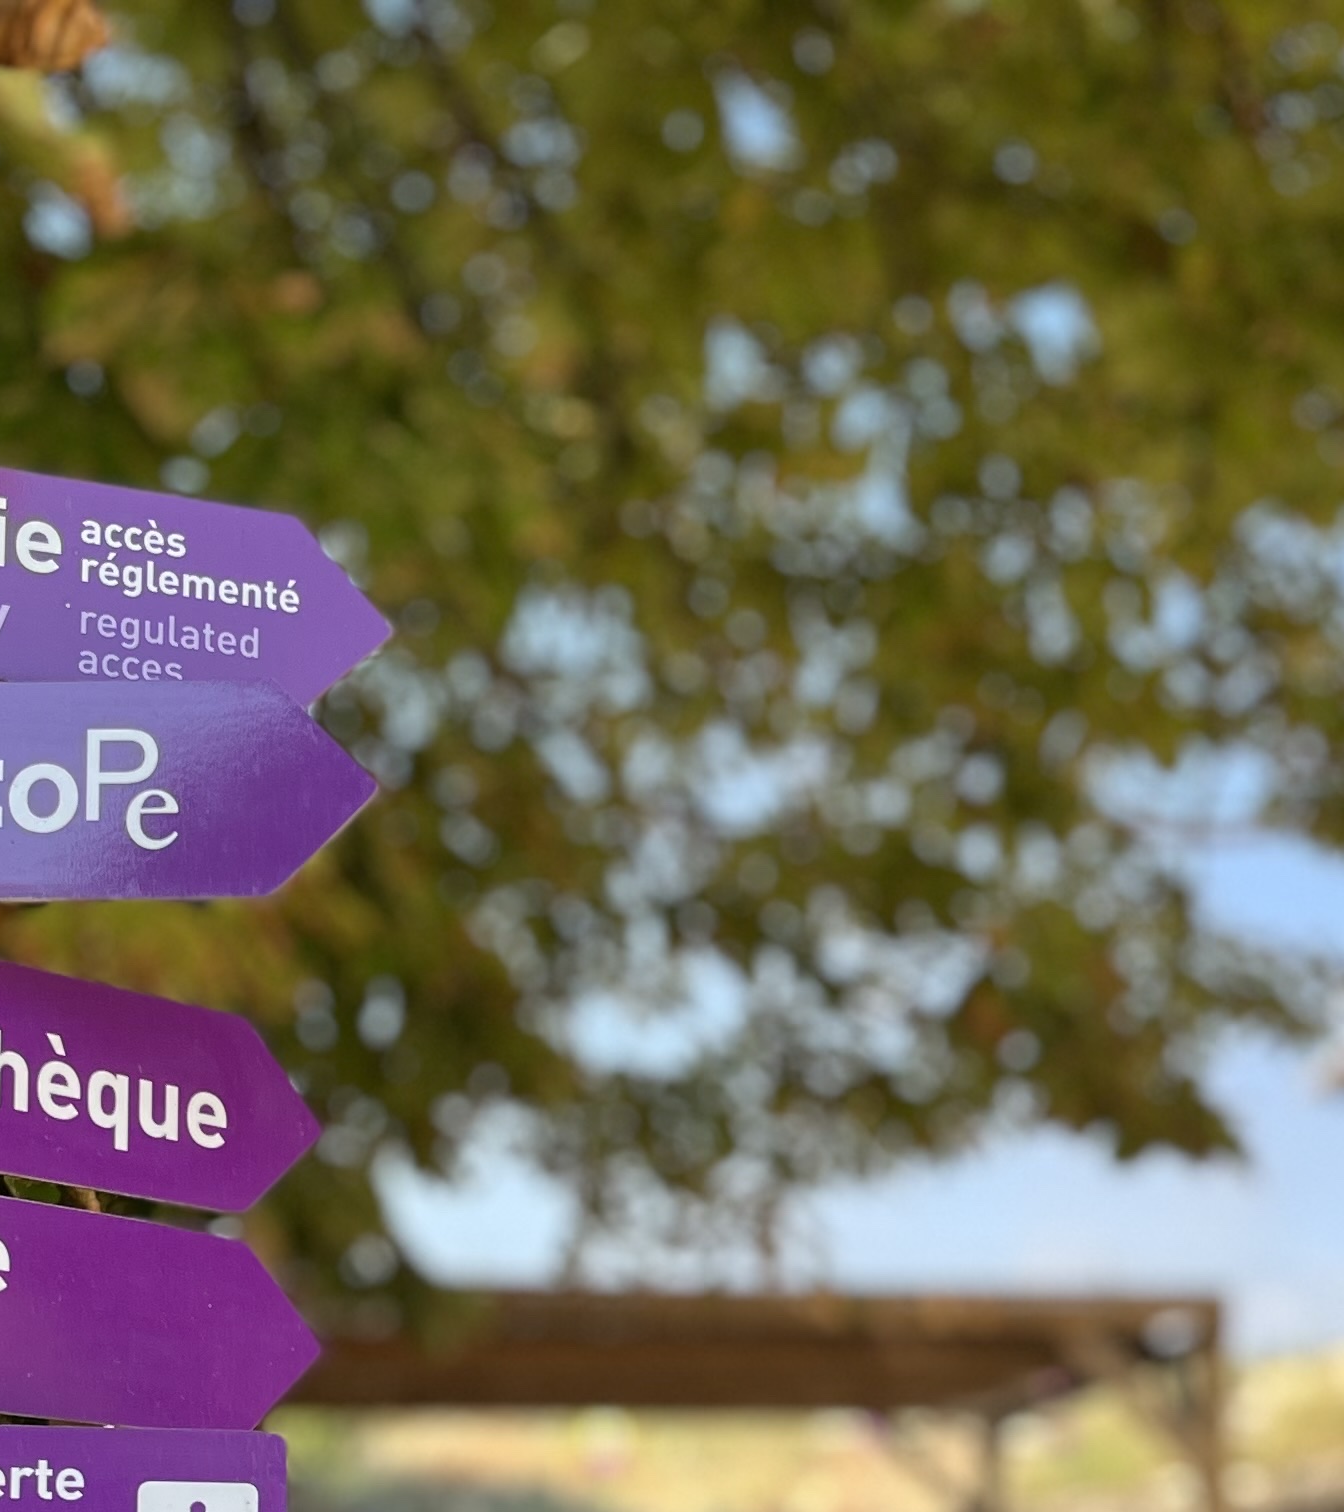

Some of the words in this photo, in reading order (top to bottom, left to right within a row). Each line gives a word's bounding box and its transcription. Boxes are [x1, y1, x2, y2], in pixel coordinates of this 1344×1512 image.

[80, 519, 187, 558] accès
[80, 552, 300, 614] réglementé
[80, 610, 260, 659] regulated
